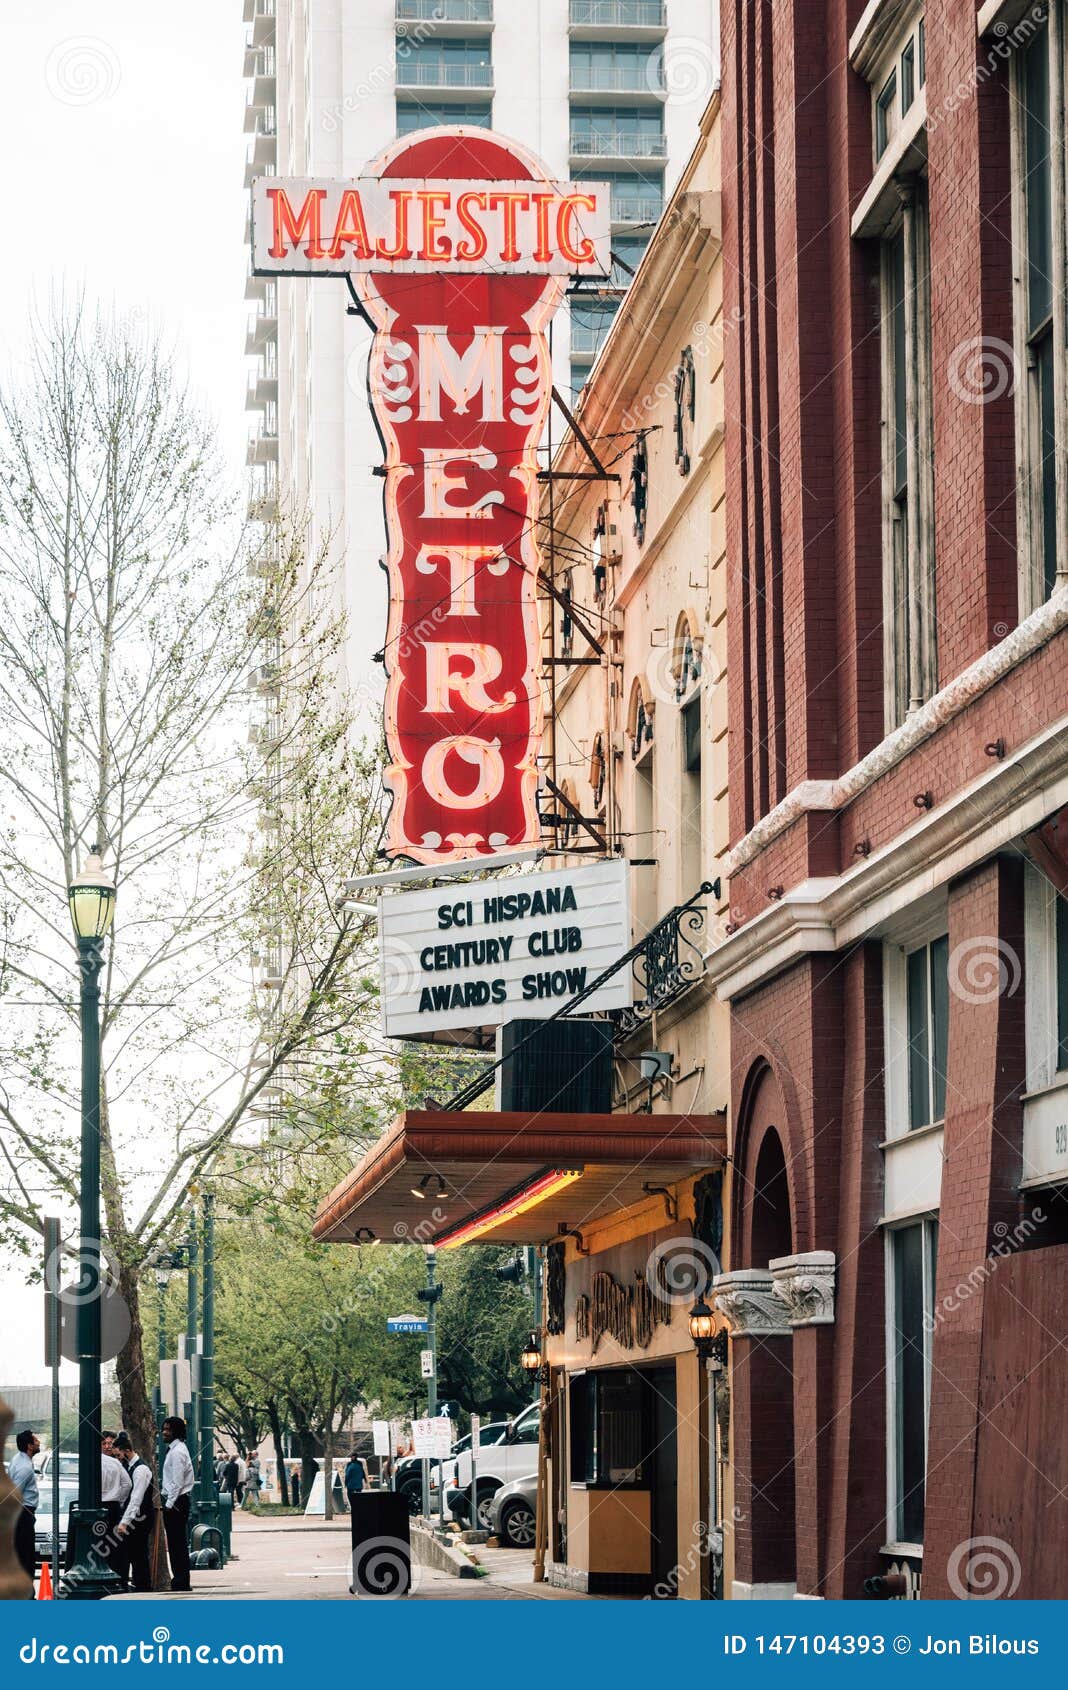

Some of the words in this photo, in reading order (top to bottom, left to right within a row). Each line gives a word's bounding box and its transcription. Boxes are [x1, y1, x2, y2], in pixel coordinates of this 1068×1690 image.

[266, 188, 597, 264] MAJESTIC
[413, 325, 515, 810] METRO
[438, 901, 473, 930] SCI
[484, 885, 578, 923] HISPANA
[420, 935, 513, 971] CENTURY
[528, 926, 582, 957] CLUB
[418, 978, 507, 1012] AWARDS
[522, 966, 587, 1000] SHOW
